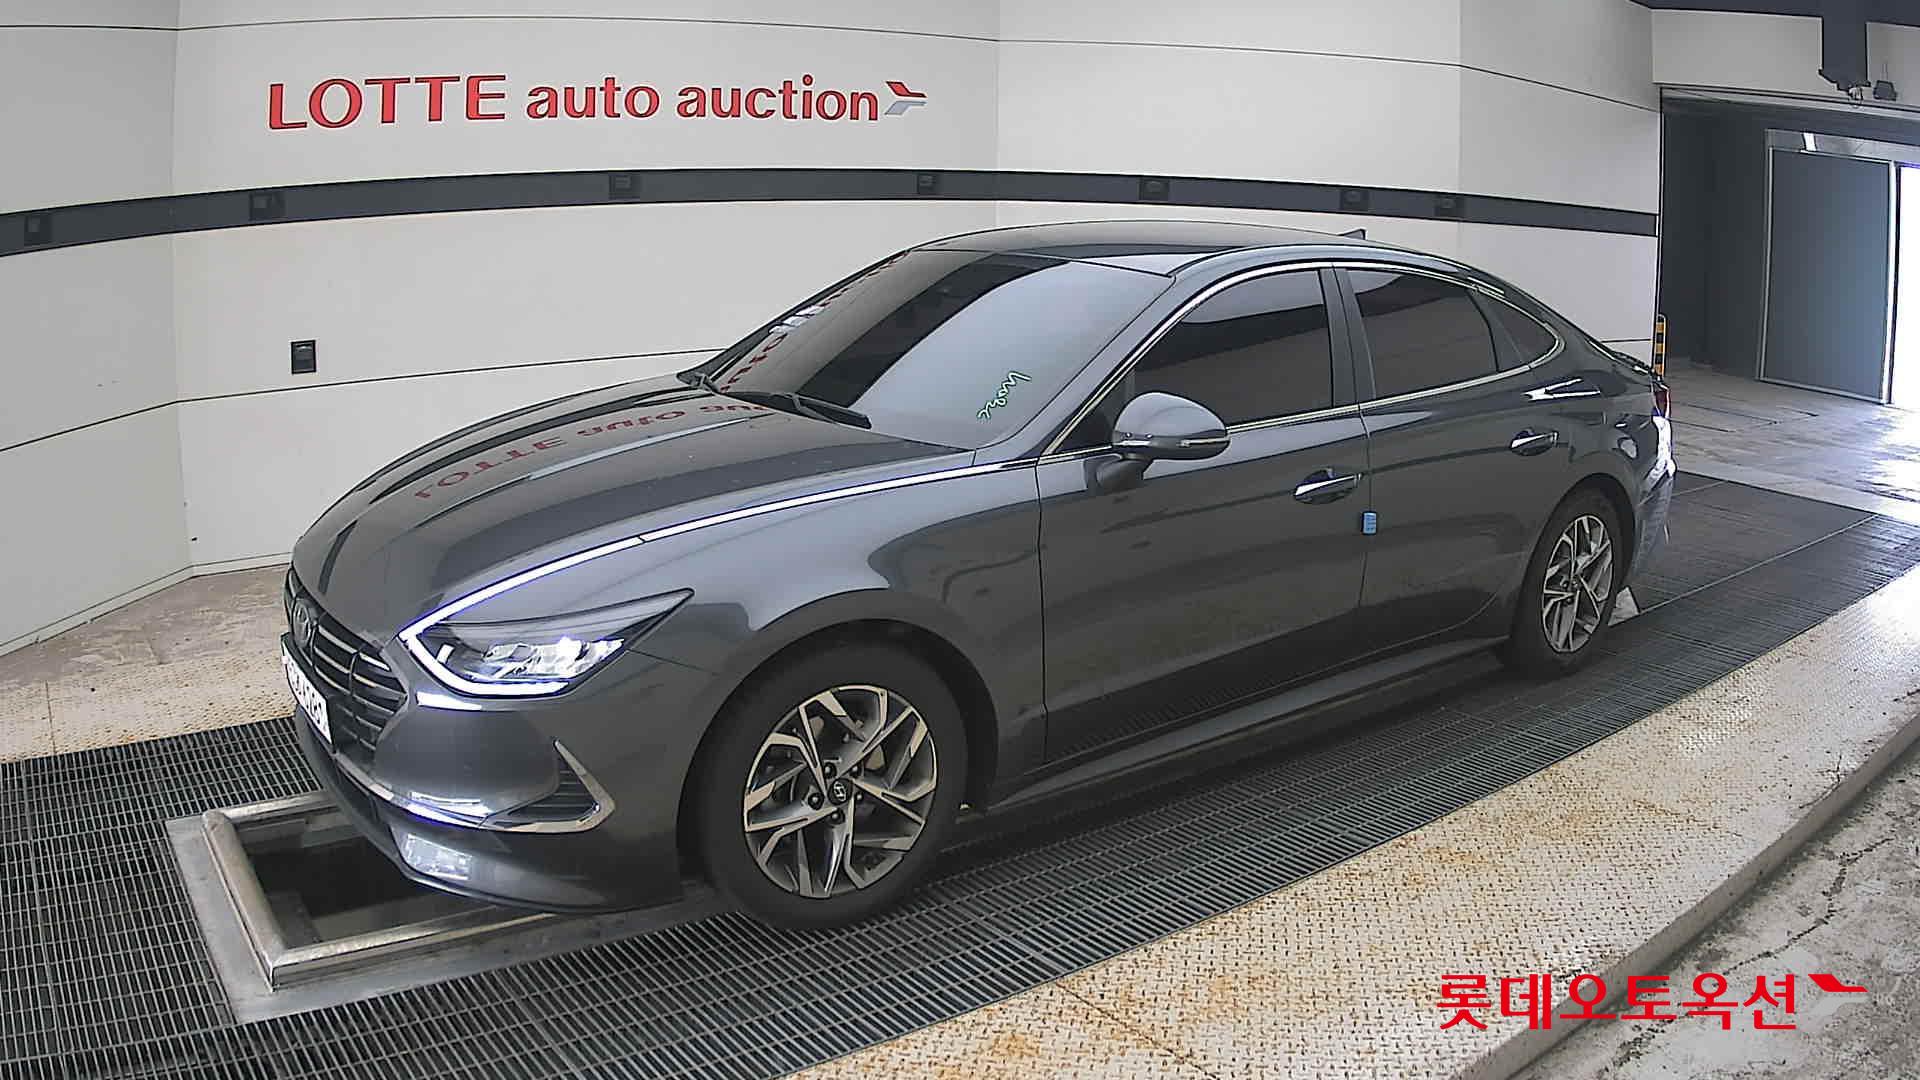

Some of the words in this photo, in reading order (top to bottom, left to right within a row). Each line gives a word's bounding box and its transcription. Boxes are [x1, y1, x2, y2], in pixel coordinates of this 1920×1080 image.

[268, 75, 507, 130] LOTTE
[526, 76, 660, 119] auto
[676, 74, 879, 121] auction
